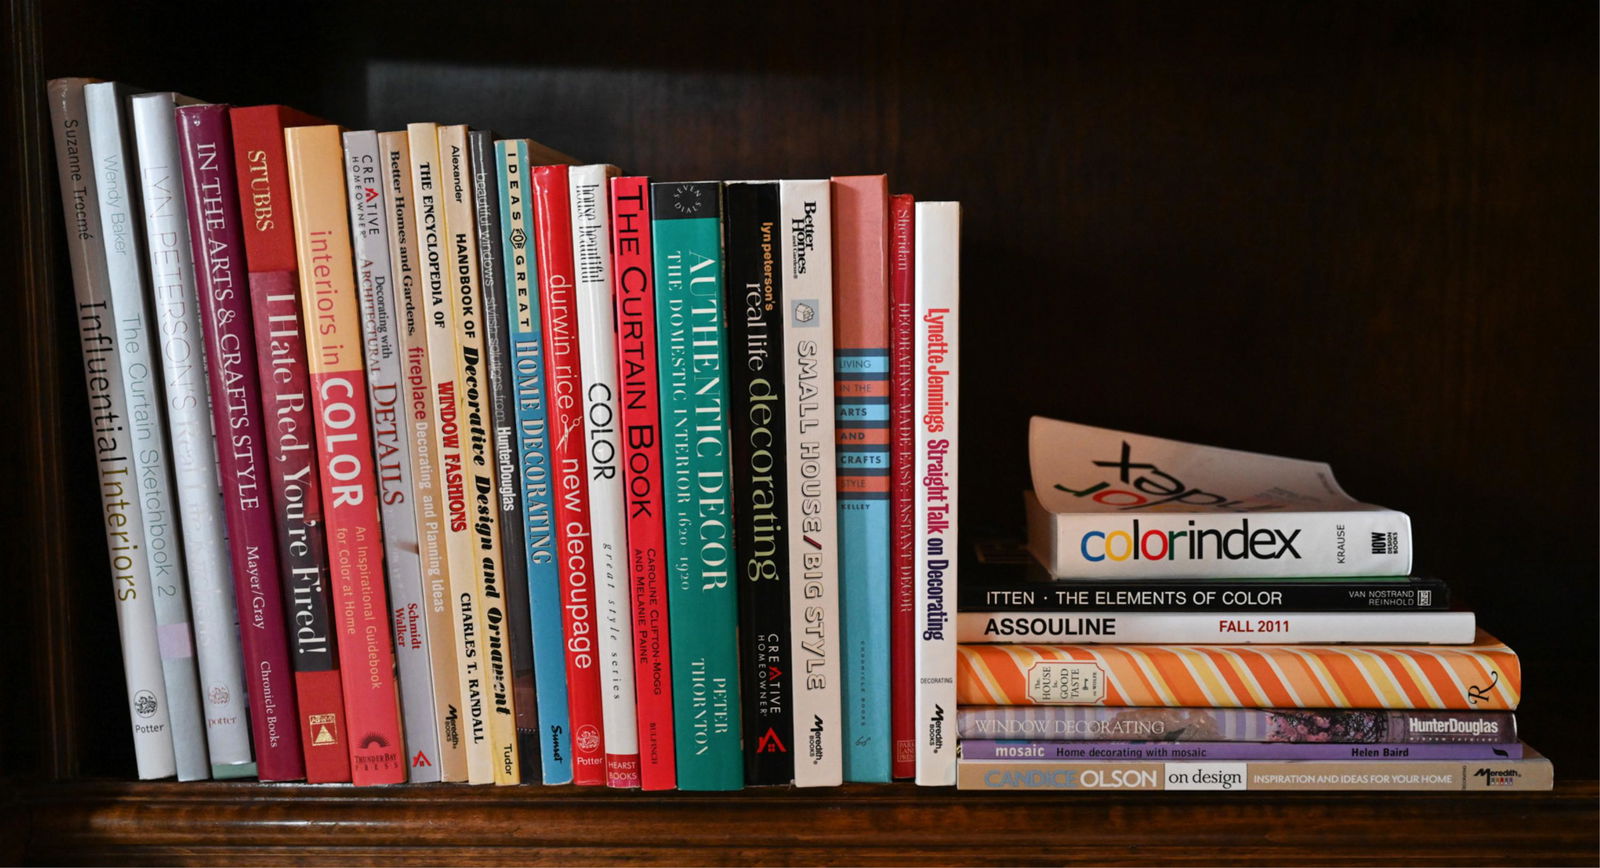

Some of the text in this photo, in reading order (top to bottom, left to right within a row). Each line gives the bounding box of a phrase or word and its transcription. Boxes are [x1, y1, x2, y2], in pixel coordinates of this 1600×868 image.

[64, 119, 94, 240] Suzanne Trocmé
[104, 154, 127, 256] Wendy Baker
[247, 150, 275, 232] STUBBS
[361, 154, 380, 236] CREATIVE
[390, 150, 411, 273] Better Homes and
[451, 145, 463, 204] Alexander
[420, 162, 446, 329] THE ENCYCLOPEDIA OF
[507, 152, 530, 327] IDEAS GREAT
[791, 218, 807, 274] Homes
[804, 200, 817, 251] Better
[898, 209, 911, 271] Sheridan
[196, 142, 259, 511] IN THE ARTS & CRAFTS STYLE
[310, 231, 344, 366] interiors in
[361, 259, 381, 373] ARCHITECTURAL
[374, 275, 393, 359] Decorating with
[549, 274, 578, 409] durwin rice
[840, 360, 872, 369] LIVING
[408, 346, 428, 420] fireplace
[456, 234, 501, 599] HANDBOOK OF Decorative Design and
[668, 251, 692, 591] THE DOMESTIC INTERIOR 1620 1920
[689, 250, 728, 592] AUTHENTIC DECOR
[798, 340, 819, 434] SMALL
[840, 384, 872, 392] IN THE
[840, 408, 867, 416] ARTS
[122, 313, 176, 597] The Curtain Sketchbook 2
[321, 377, 364, 509] COLOR
[372, 382, 405, 505] DETAILS
[438, 380, 467, 533] WINDOW FASHIONS
[515, 338, 552, 566] HOME DECORATING
[588, 383, 616, 481] COLOR
[746, 283, 782, 582] real life decorating
[840, 432, 865, 440] AND
[840, 455, 882, 464] CRAFTS
[268, 313, 327, 654] Hate Red, You're Fired!
[841, 480, 866, 488] STYLE
[923, 308, 950, 641] Lynette Jennings Straight Talk on Decorating
[415, 422, 445, 613] Decorating and Planning Ideas
[1080, 518, 1302, 562] colorindex
[1336, 524, 1345, 564] KRAUSE
[1371, 532, 1386, 555] HOW
[245, 545, 266, 630] Mayer/Gray
[336, 528, 356, 635] for Color at Home
[561, 459, 592, 669] new decoupage
[986, 591, 1283, 605] ITTEN THE ELEMENTS OF COLOR
[1349, 590, 1415, 598] VAN NOSTRAND
[354, 526, 380, 689] An Inspirational Guidebook
[395, 608, 406, 647] Walker
[407, 603, 422, 650] Schmidt
[603, 543, 622, 700] great style series
[634, 550, 649, 664] AND MELANIE PAINE
[647, 548, 662, 695] CAROLINE CLIFTON-MOGG
[984, 618, 1289, 636] ASSOULINE FALL 2011
[260, 660, 280, 748] Chronicle Books
[460, 592, 485, 744] CHARLES RANDALL
[691, 657, 709, 755] THORNTON
[713, 678, 729, 734] PETER
[768, 633, 783, 714] CREATIVE
[920, 677, 953, 685] DECORATING
[1042, 666, 1051, 700] HOUSE
[1060, 668, 1069, 699] GOOD
[1071, 669, 1080, 699] TASTE
[135, 723, 165, 734] Potter
[503, 743, 513, 776] Tudor
[577, 757, 602, 765] Potter
[608, 761, 636, 770] HEARST
[975, 720, 1165, 734] WINDOW DECORATING
[995, 744, 1409, 758] mosaic Home decorating with mosaic Helen Baird
[609, 772, 637, 780] BOOKS
[984, 769, 1453, 789] CANDICE OLSON on design INSPIRATION AND IDEAS FOR YOUR HOME
